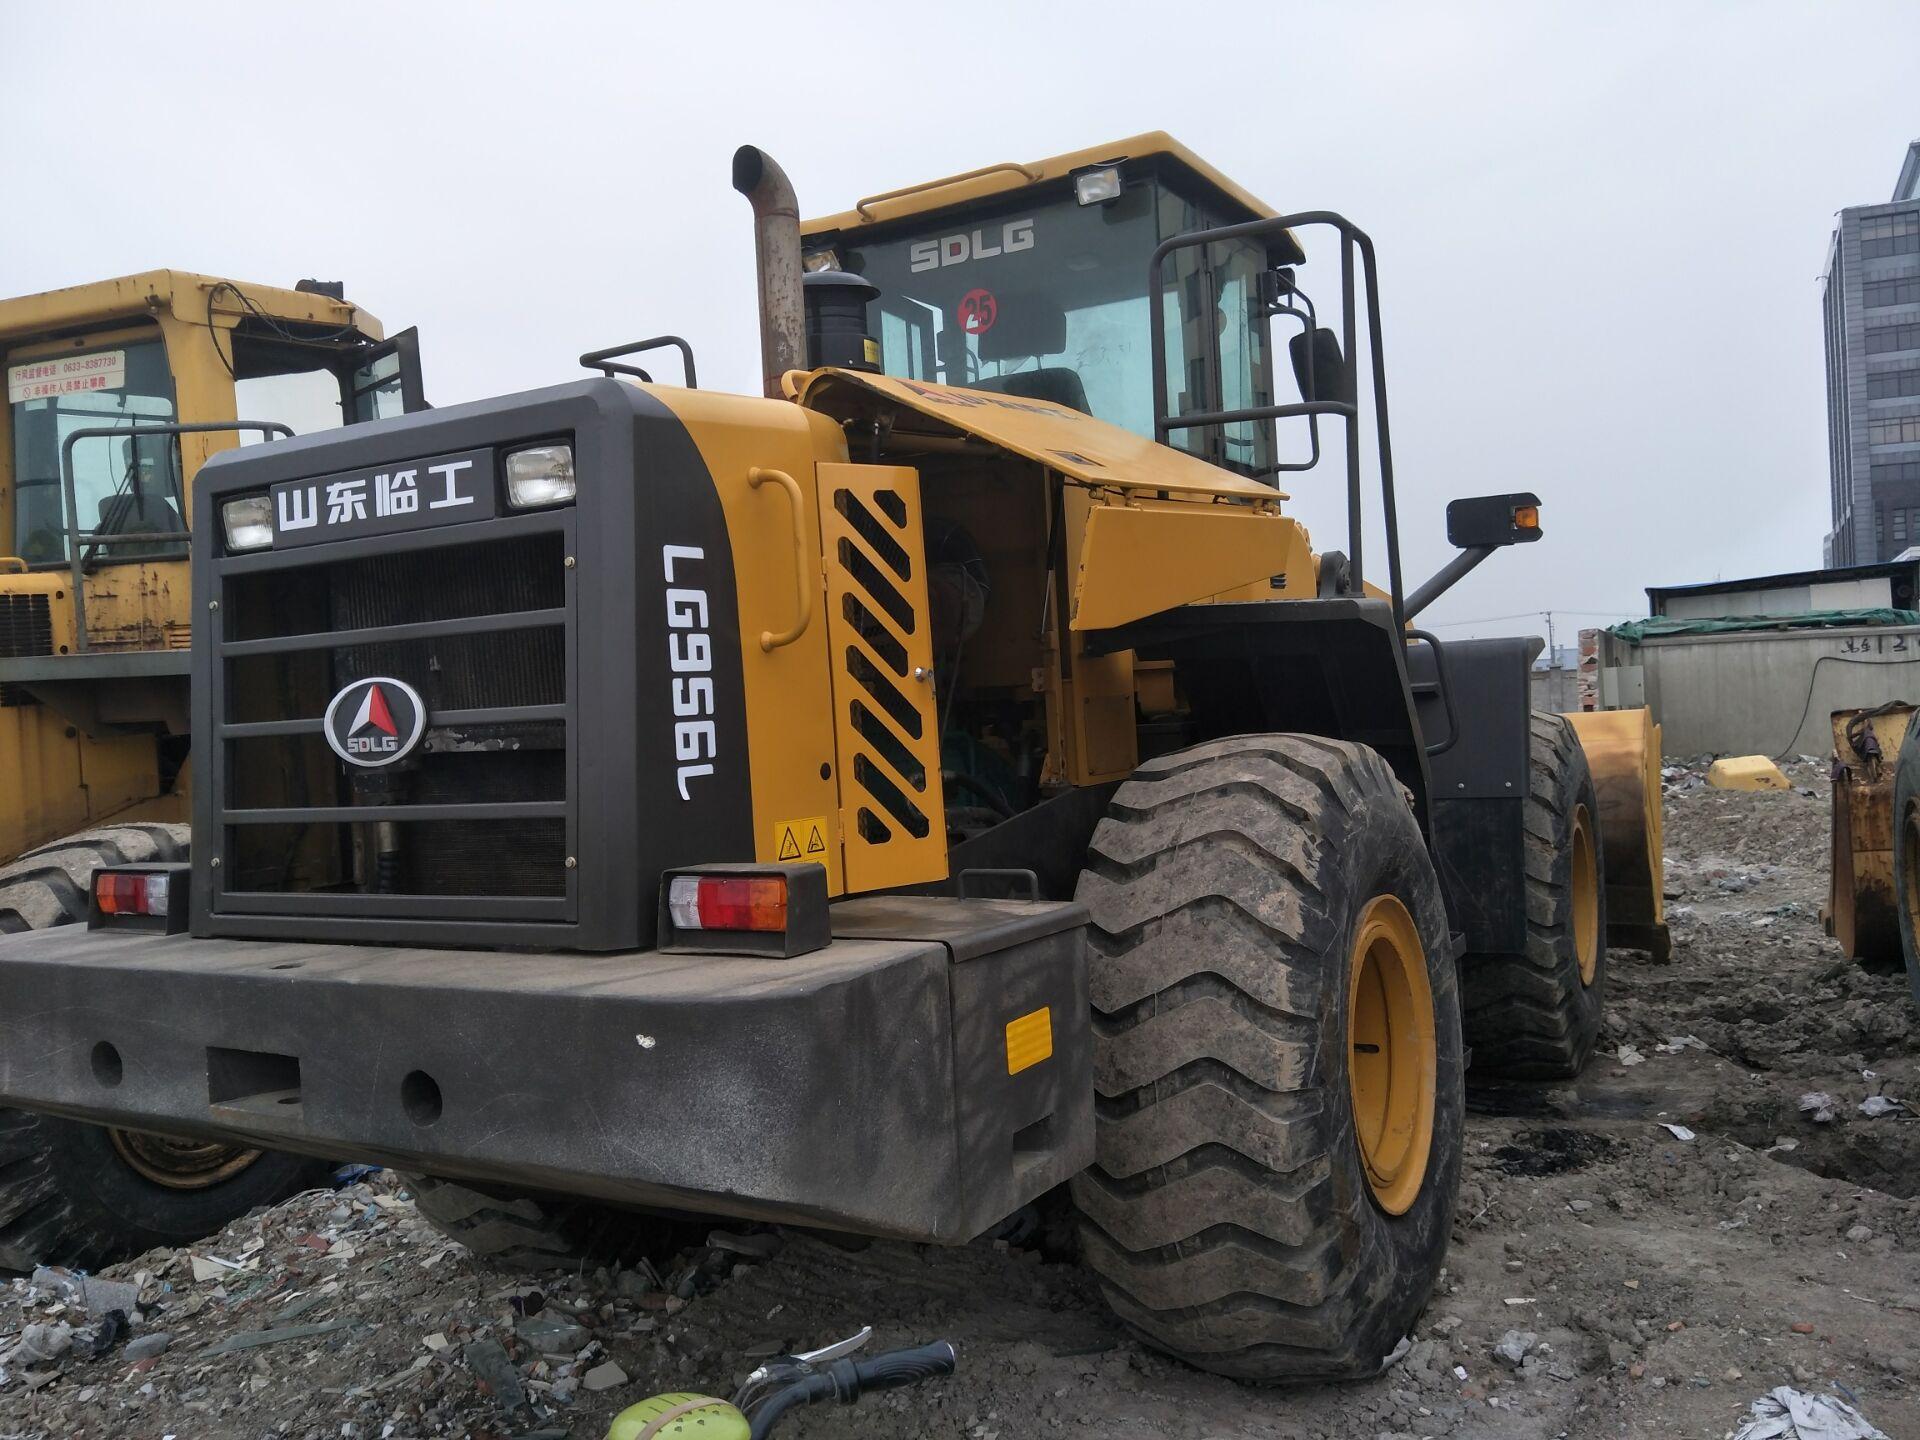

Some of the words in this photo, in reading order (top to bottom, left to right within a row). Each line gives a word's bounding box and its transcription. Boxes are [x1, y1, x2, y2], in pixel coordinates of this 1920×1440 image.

[910, 218, 1035, 273] SDLG
[965, 295, 992, 329] 25
[278, 460, 474, 532] 山东临工
[663, 544, 717, 801] LG956L
[347, 736, 399, 753] SDLG
